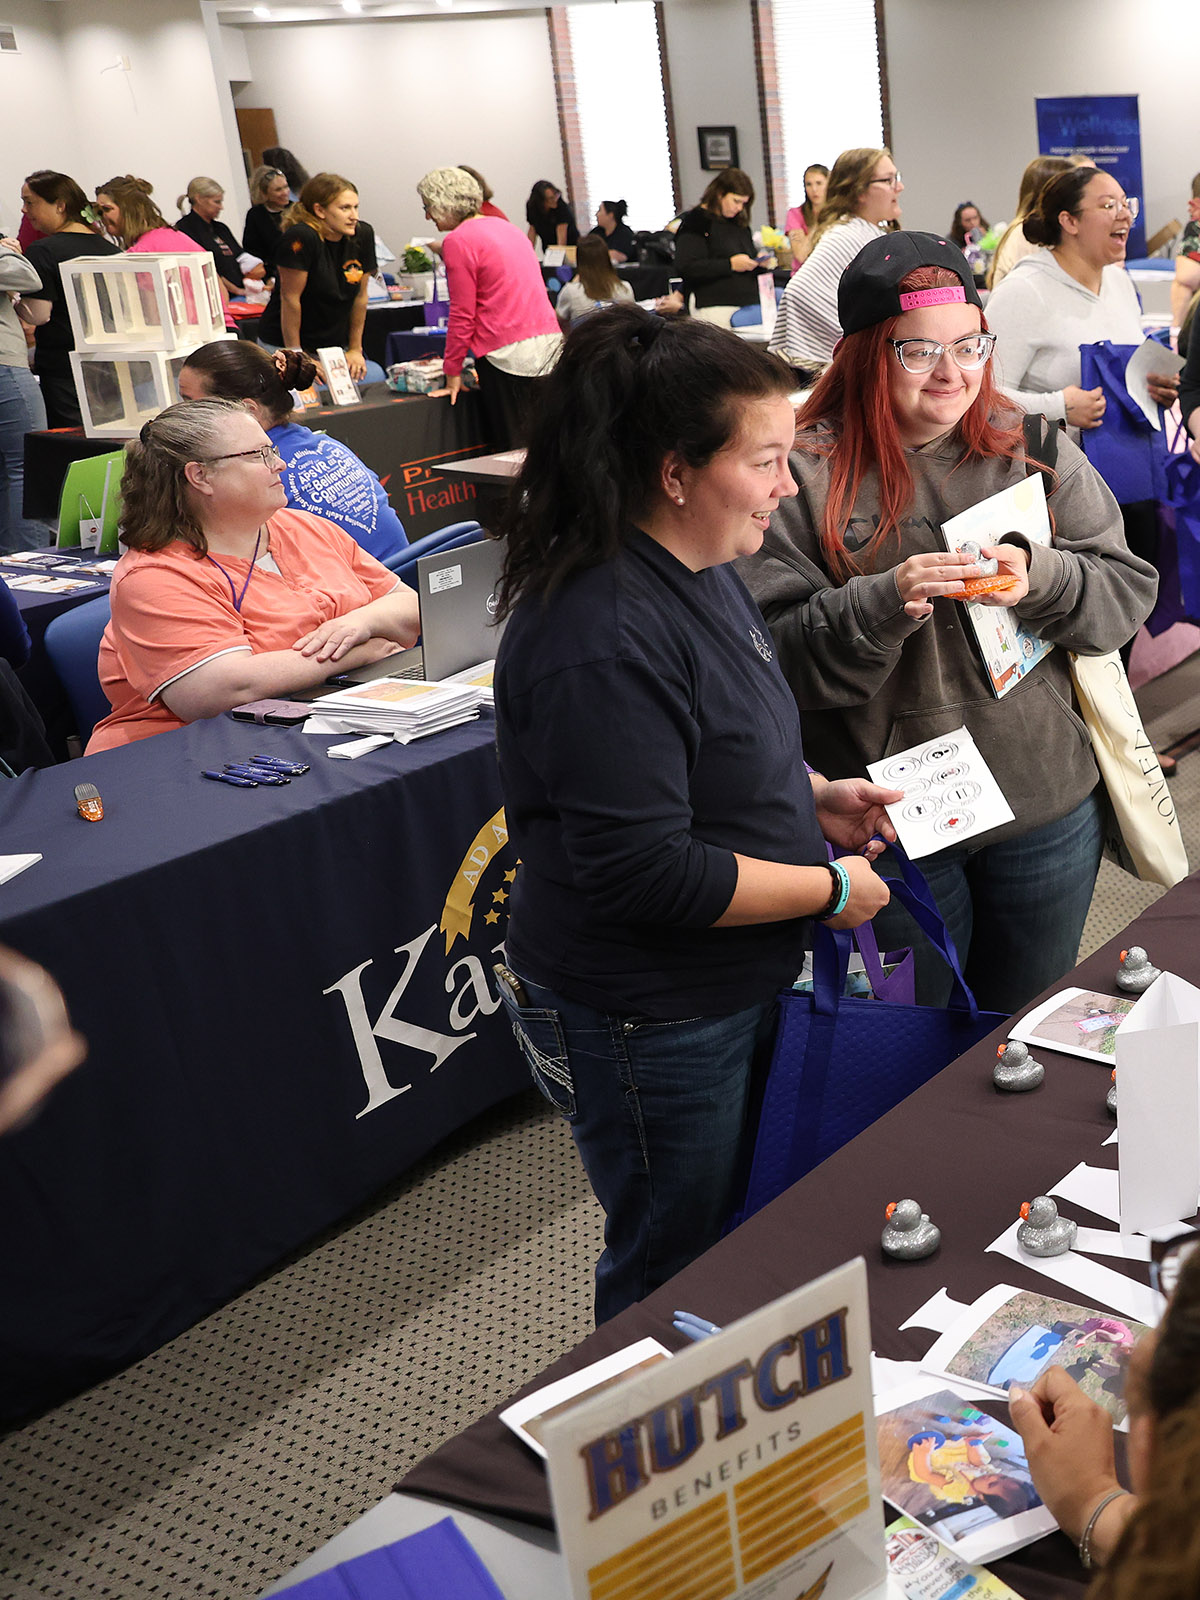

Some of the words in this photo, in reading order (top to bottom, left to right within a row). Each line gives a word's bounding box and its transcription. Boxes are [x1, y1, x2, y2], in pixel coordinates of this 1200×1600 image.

[310, 468, 366, 504] Communities
[312, 468, 347, 492] Believe
[405, 481, 477, 516] Health
[463, 845, 489, 886] AD
[578, 1306, 853, 1523] HUTCH
[650, 1421, 802, 1521] BENEFITS
[919, 1573, 944, 1596] never
[945, 1560, 962, 1576] get
[934, 1556, 951, 1571] can
[930, 1568, 965, 1599] enough
